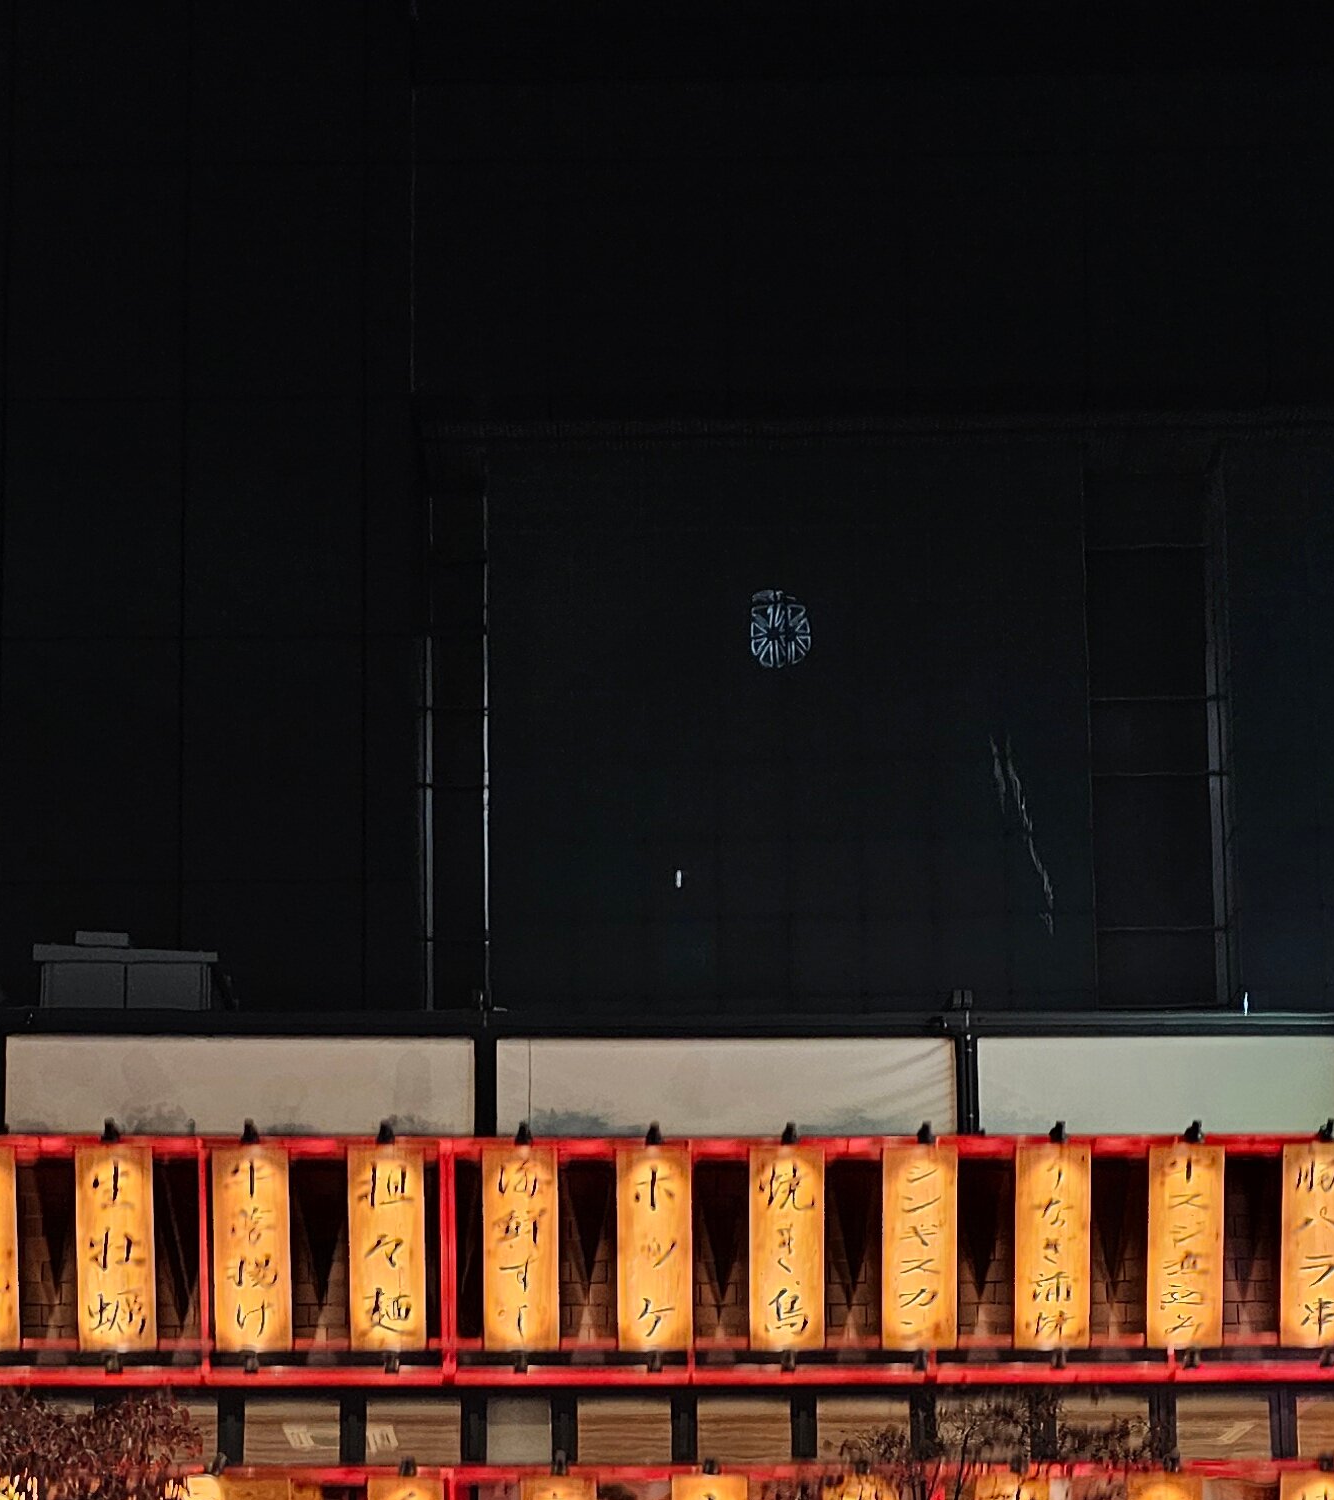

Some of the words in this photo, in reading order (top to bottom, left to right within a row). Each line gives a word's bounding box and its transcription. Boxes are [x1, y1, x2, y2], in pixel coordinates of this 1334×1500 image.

[634, 1165, 677, 1337] ホッケ
[759, 1160, 815, 1334] 焼き鳥
